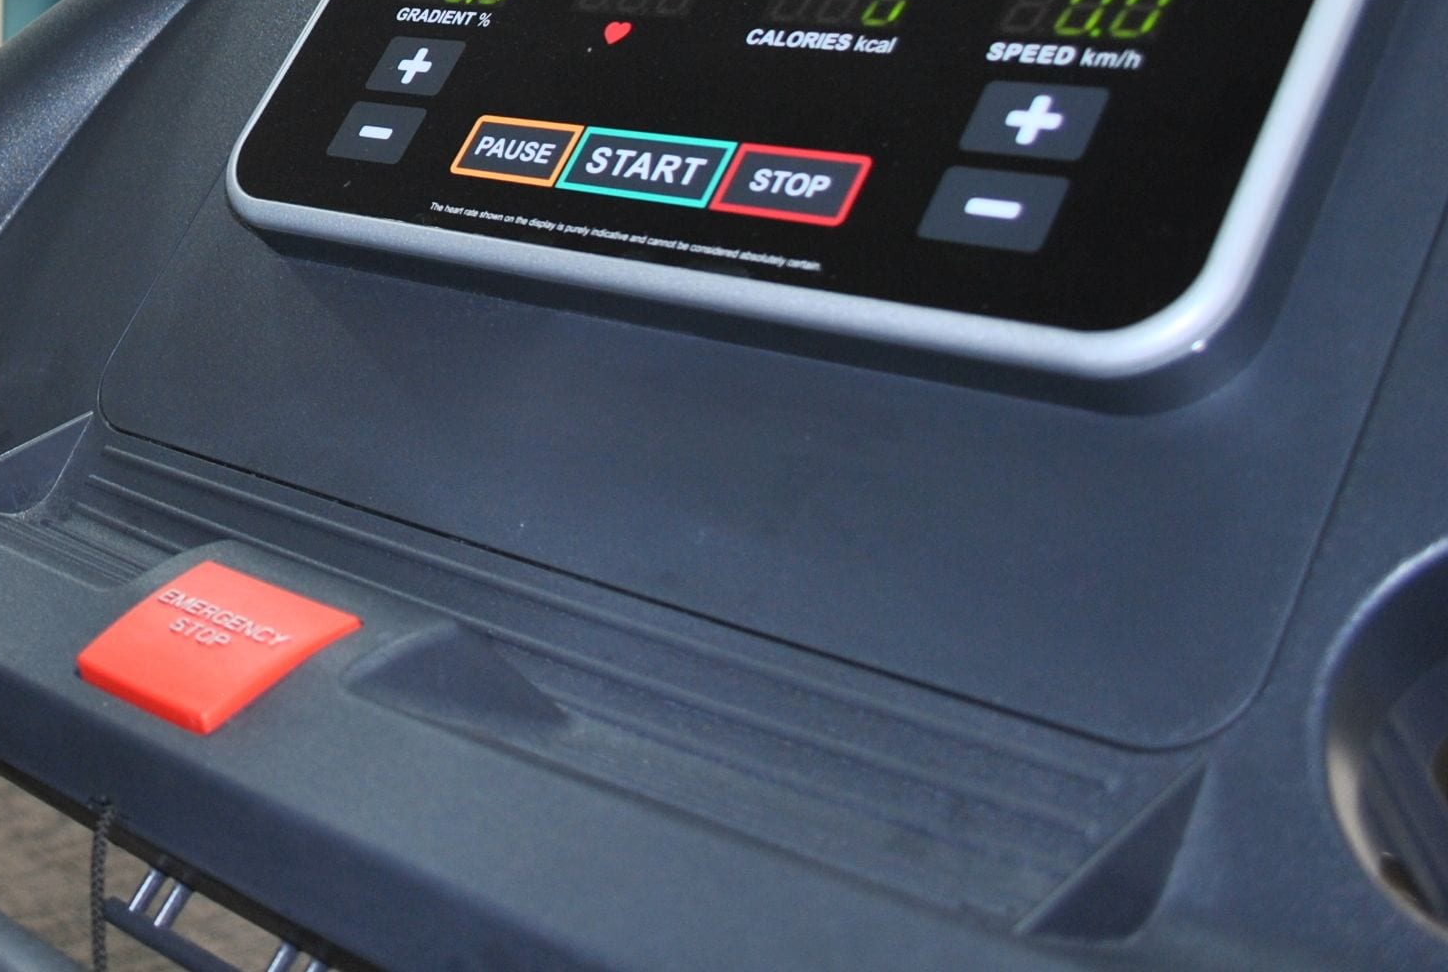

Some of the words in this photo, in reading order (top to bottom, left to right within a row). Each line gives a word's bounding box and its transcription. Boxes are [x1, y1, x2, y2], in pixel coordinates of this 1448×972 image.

[396, 7, 475, 26] GRADIENT
[478, 11, 492, 28] %
[746, 28, 853, 52] CALORIES
[853, 36, 898, 54] kcal
[986, 41, 1077, 66] SPEED
[1079, 47, 1145, 70] km/h
[474, 135, 557, 165] PAUSE
[585, 147, 708, 186] START
[749, 168, 832, 199] STOP
[430, 202, 444, 212] The
[444, 204, 464, 216] heart
[463, 207, 479, 218] rate
[478, 211, 504, 222] shown
[504, 215, 515, 223] on
[515, 216, 528, 226] the
[528, 218, 556, 230] display
[556, 221, 564, 230] is
[563, 224, 591, 236] purely
[590, 227, 630, 242] indicative
[629, 233, 648, 244] and
[647, 236, 678, 250] cannot
[676, 240, 690, 251] be
[689, 243, 740, 259] considered
[739, 251, 786, 268] absolutely
[785, 258, 822, 272] certain.
[157, 588, 292, 646] EMERGENCY
[169, 617, 232, 648] STOP
